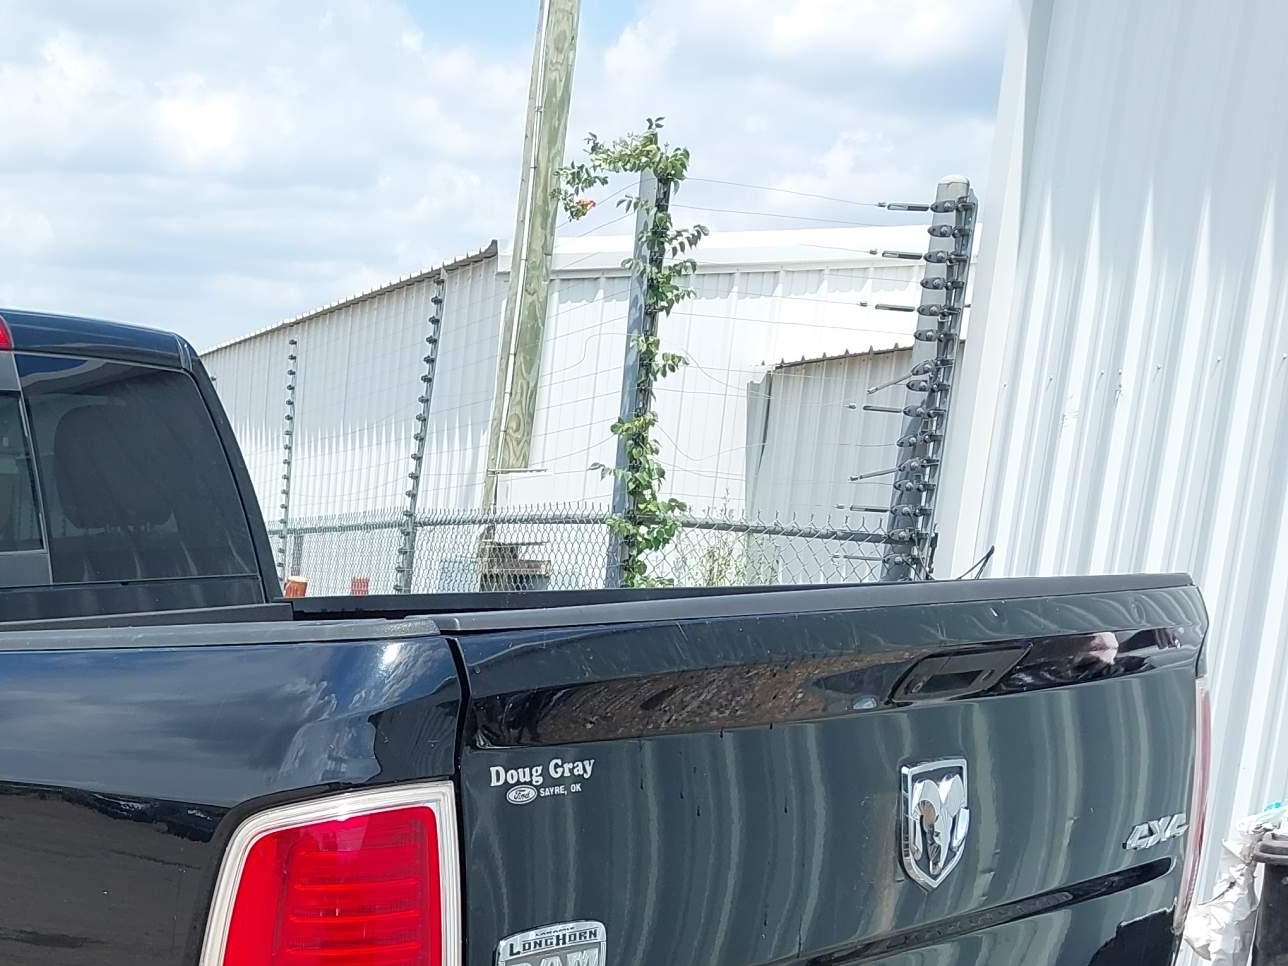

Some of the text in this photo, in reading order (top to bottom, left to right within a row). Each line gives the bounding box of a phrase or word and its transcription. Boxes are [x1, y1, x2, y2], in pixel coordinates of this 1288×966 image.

[489, 758, 595, 787] Doug Gray
[539, 785, 568, 797] SAYRE,
[570, 783, 582, 793] OK
